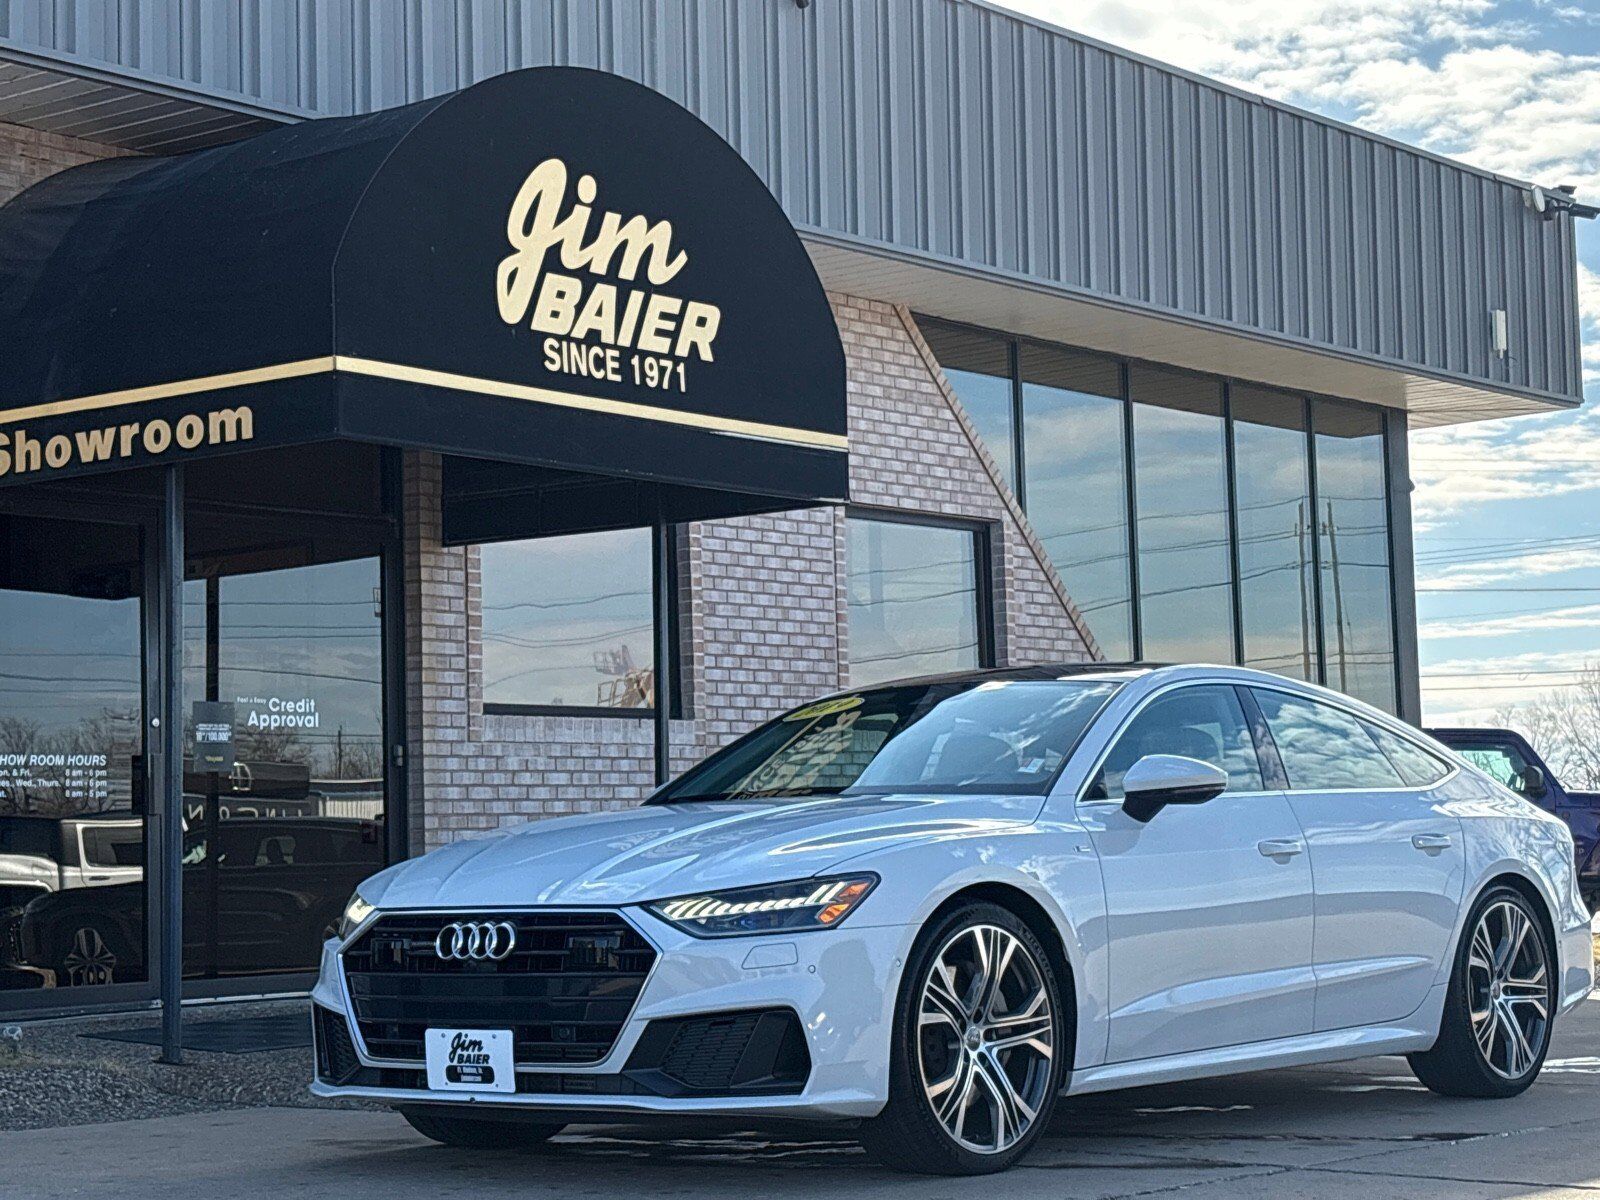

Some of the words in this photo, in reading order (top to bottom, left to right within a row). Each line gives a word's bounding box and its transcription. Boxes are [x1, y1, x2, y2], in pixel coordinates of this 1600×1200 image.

[496, 158, 688, 325] Jim
[530, 272, 721, 362] BAIER
[543, 337, 622, 382] SINCE
[631, 354, 686, 393] 1971
[268, 697, 316, 713] Credit
[247, 710, 319, 730] Approval
[0, 754, 27, 766] HOW
[29, 754, 65, 766] ROOM
[67, 754, 107, 766] HOURS
[0, 769, 10, 777] on.
[19, 768, 32, 777] Fri.
[95, 769, 107, 778] pm
[95, 780, 107, 788] pm
[95, 791, 107, 799] pm
[448, 1032, 484, 1063] Jim
[457, 1053, 491, 1065] BAIER
